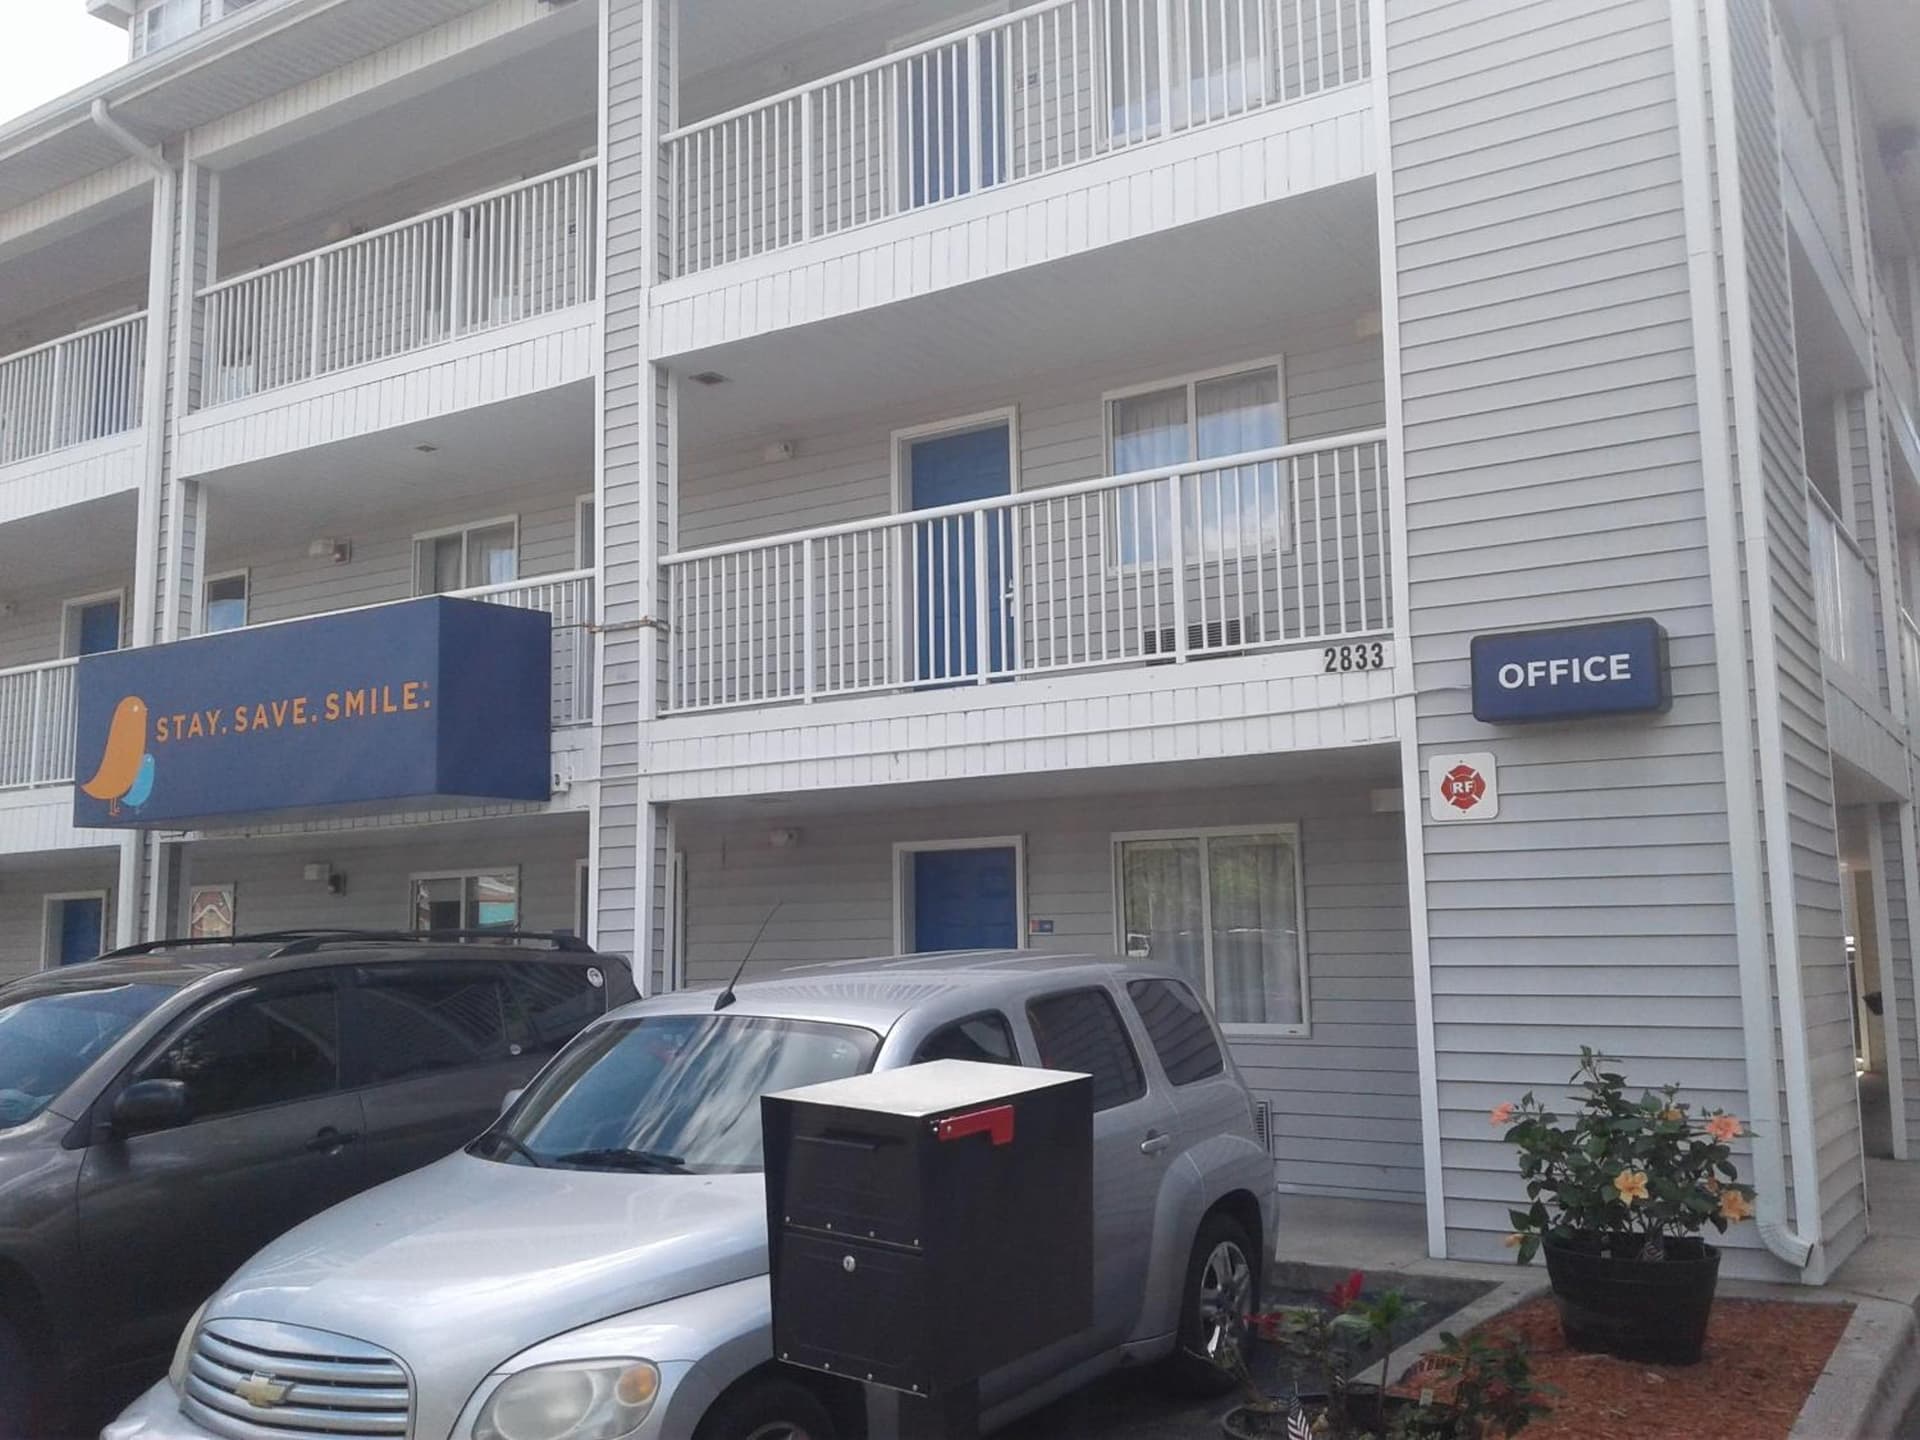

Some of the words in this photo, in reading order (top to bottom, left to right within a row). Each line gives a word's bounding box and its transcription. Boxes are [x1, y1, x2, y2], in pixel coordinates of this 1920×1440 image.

[1324, 643, 1384, 672] 2833
[1498, 653, 1632, 689] OFFICE
[156, 709, 227, 742] STAY.
[234, 697, 317, 733] SAVE.
[1452, 781, 1474, 793] RF
